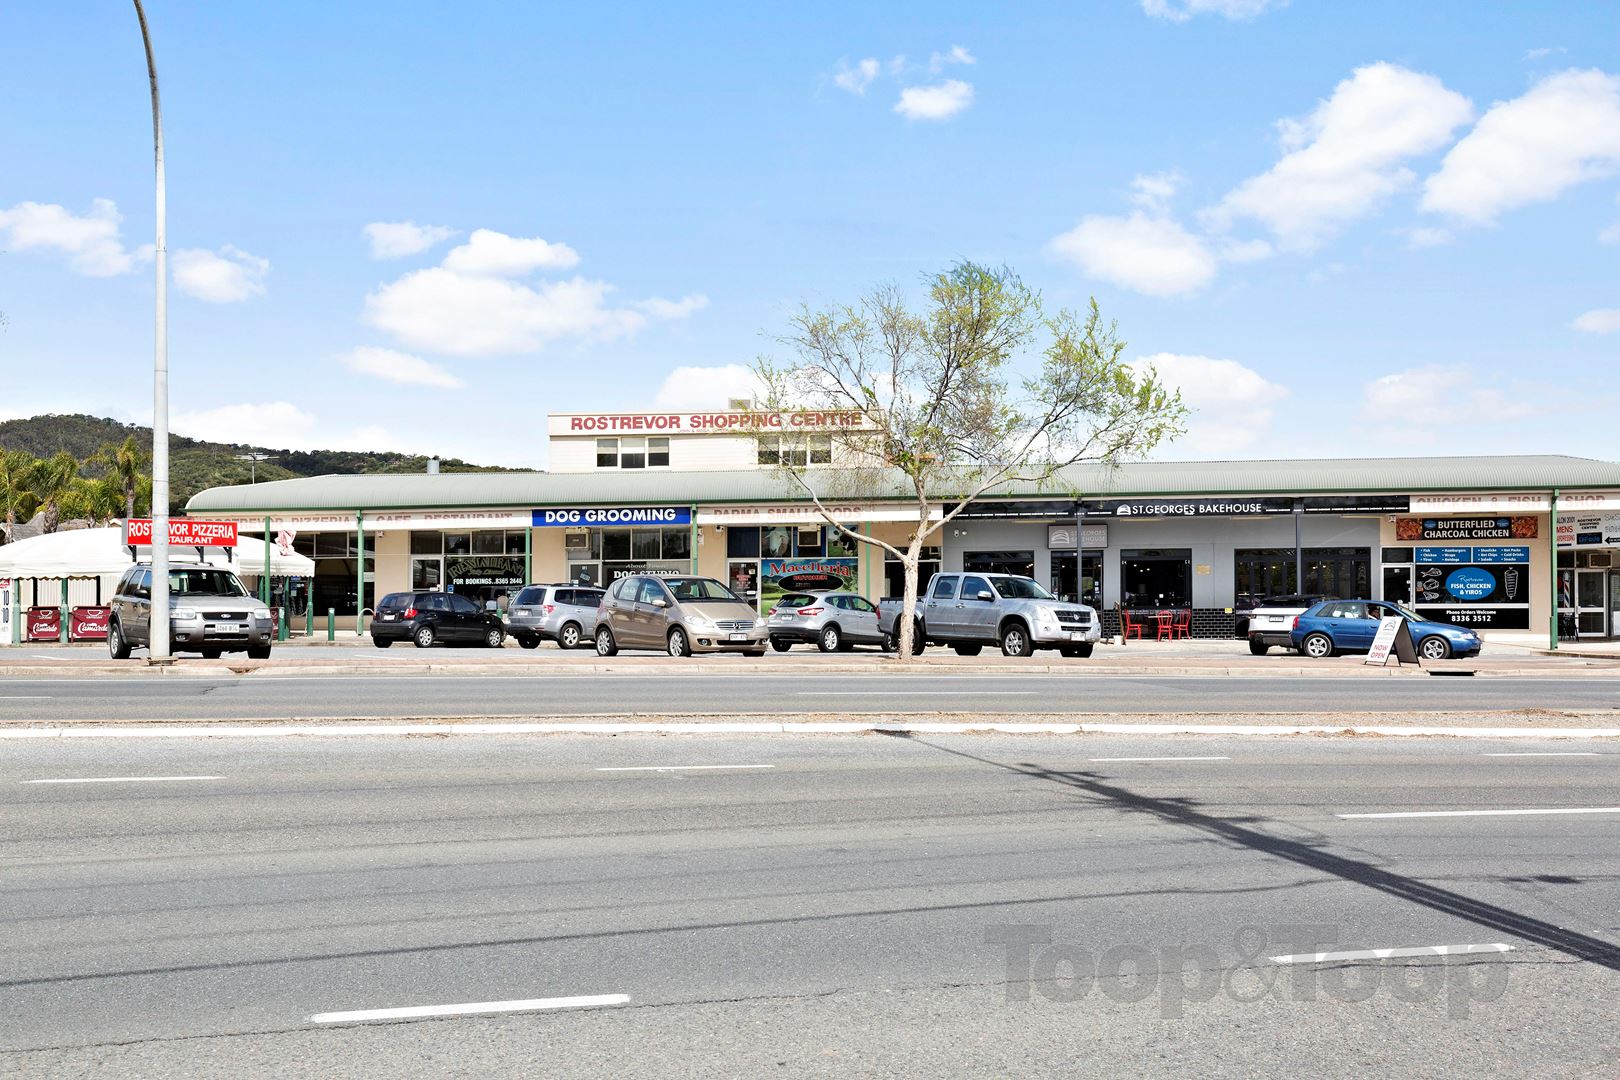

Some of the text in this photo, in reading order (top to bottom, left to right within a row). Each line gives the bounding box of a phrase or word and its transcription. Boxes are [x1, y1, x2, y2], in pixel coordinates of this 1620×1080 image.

[571, 411, 863, 430] ROSTREVOR SHOPPING CENTRE
[713, 507, 760, 518] PARMA
[1199, 503, 1262, 513] BAKEHOUSE
[545, 508, 676, 523] DOG GROOMING
[1438, 520, 1495, 529] BUTTERFLIED
[128, 521, 189, 537] ROSVOR
[192, 523, 234, 540] PIZZERIA
[1424, 529, 1509, 538] CHARCOAL CHICKEN
[769, 561, 851, 577] Macelleria
[453, 577, 464, 585] FOR
